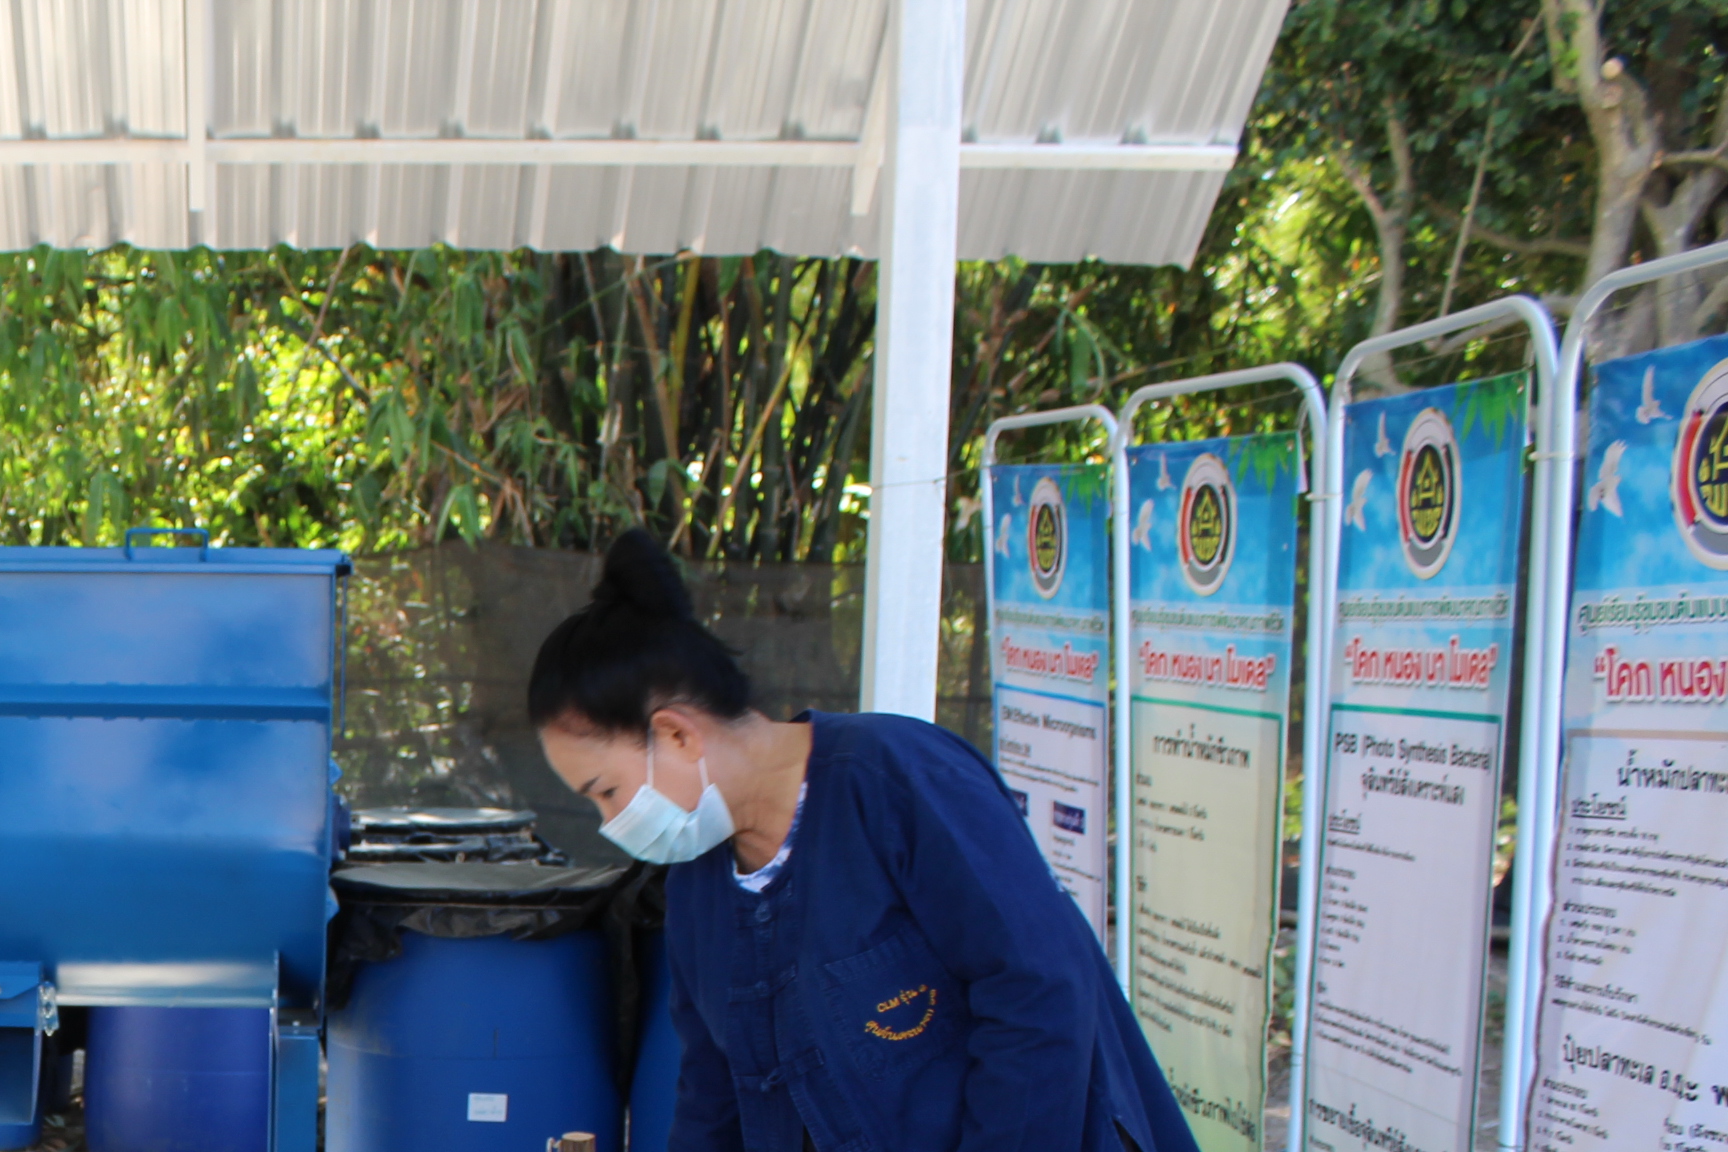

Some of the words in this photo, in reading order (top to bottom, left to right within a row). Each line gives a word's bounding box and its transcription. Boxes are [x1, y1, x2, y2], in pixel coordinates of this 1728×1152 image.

[1335, 731, 1358, 753] PSB
[1617, 749, 1728, 794] น้ำหมักปลาทะ
